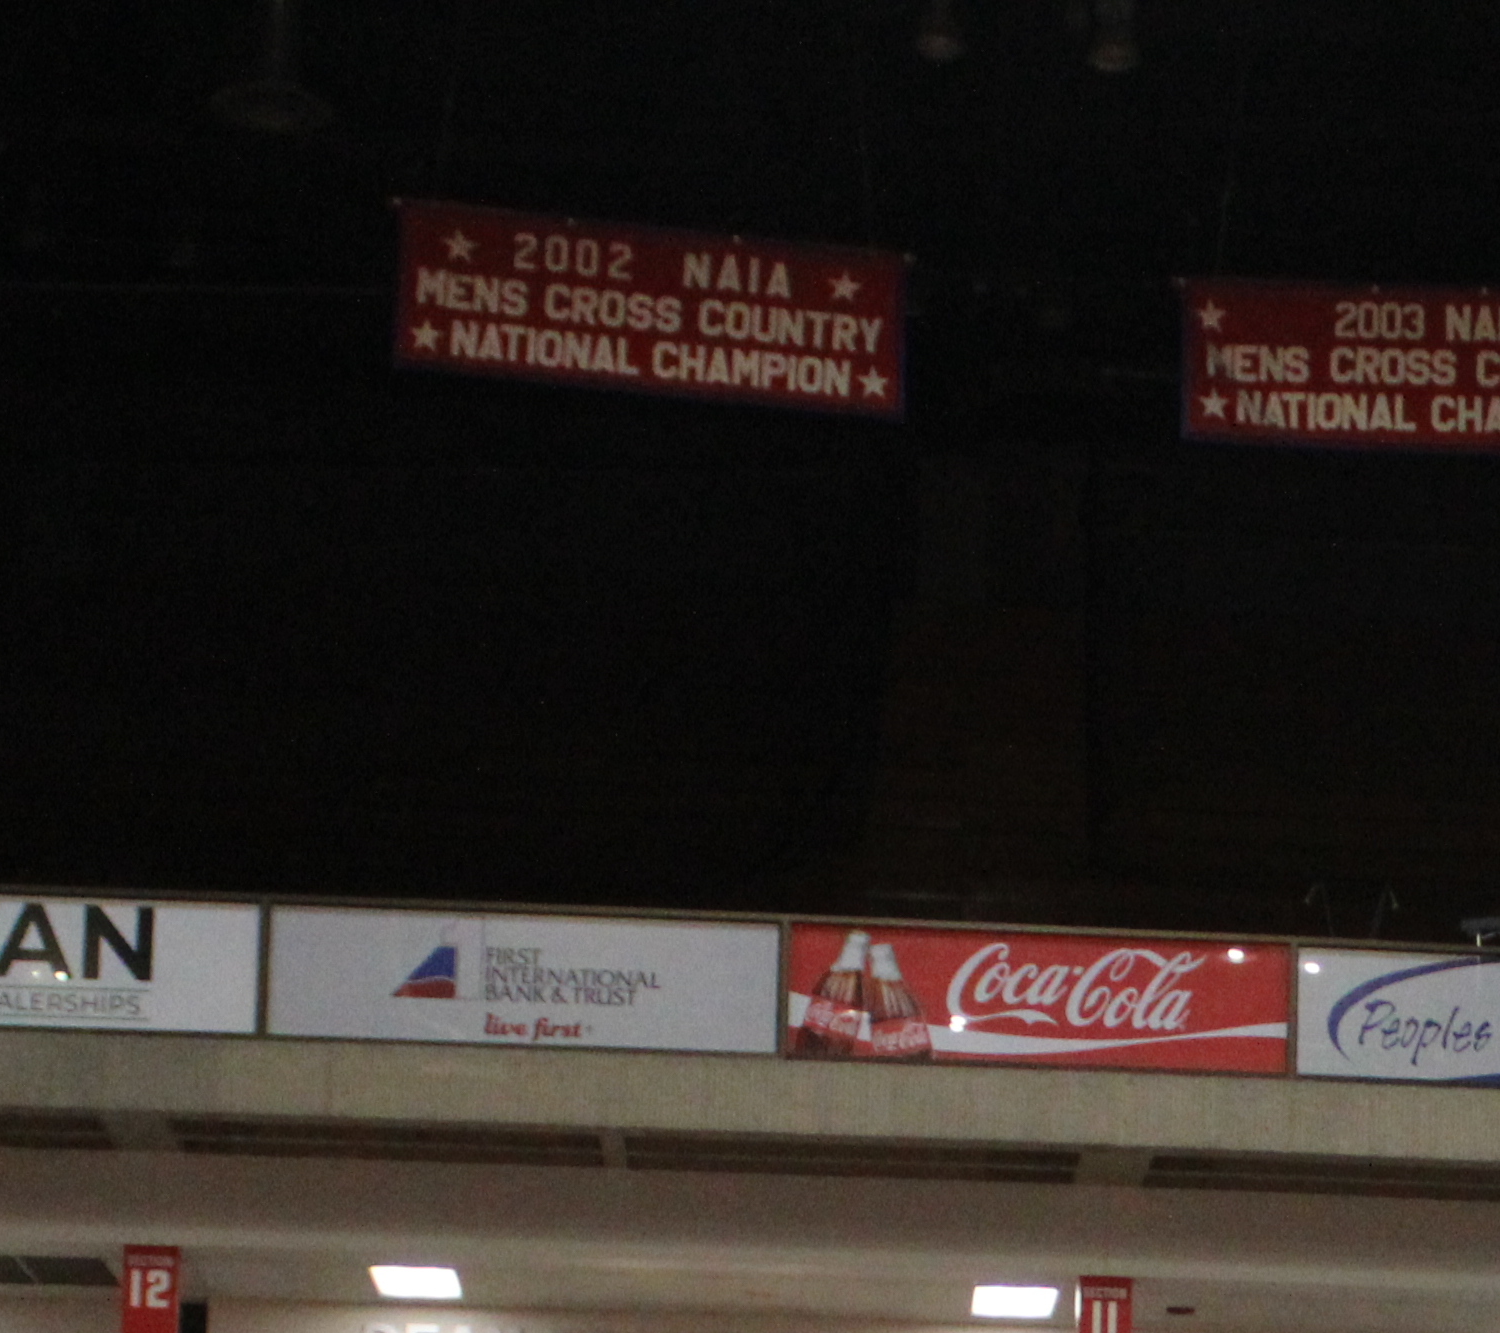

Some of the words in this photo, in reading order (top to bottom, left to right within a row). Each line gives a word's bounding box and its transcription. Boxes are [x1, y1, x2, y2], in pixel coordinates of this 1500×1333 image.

[513, 231, 634, 281] 2002
[683, 252, 792, 300] NAIA
[416, 266, 529, 317] MENS
[545, 283, 682, 332] CROSS
[700, 299, 883, 353] COUNTRY
[1334, 301, 1424, 339] 2003
[450, 320, 639, 376] NATIONAL
[652, 341, 851, 396] CHAMPION
[1206, 344, 1310, 384] MENS
[1329, 347, 1456, 386] CROSS
[1236, 390, 1416, 431] NATIONAL
[486, 946, 544, 964] FIRST
[485, 966, 661, 990] INTERNATIONAL
[486, 984, 547, 1003] BANK
[550, 986, 573, 1004] &
[580, 987, 641, 1007] TRUST
[484, 1014, 528, 1037] live
[531, 1017, 583, 1041] first
[1358, 1000, 1491, 1065] Peoples
[129, 1268, 172, 1309] 12
